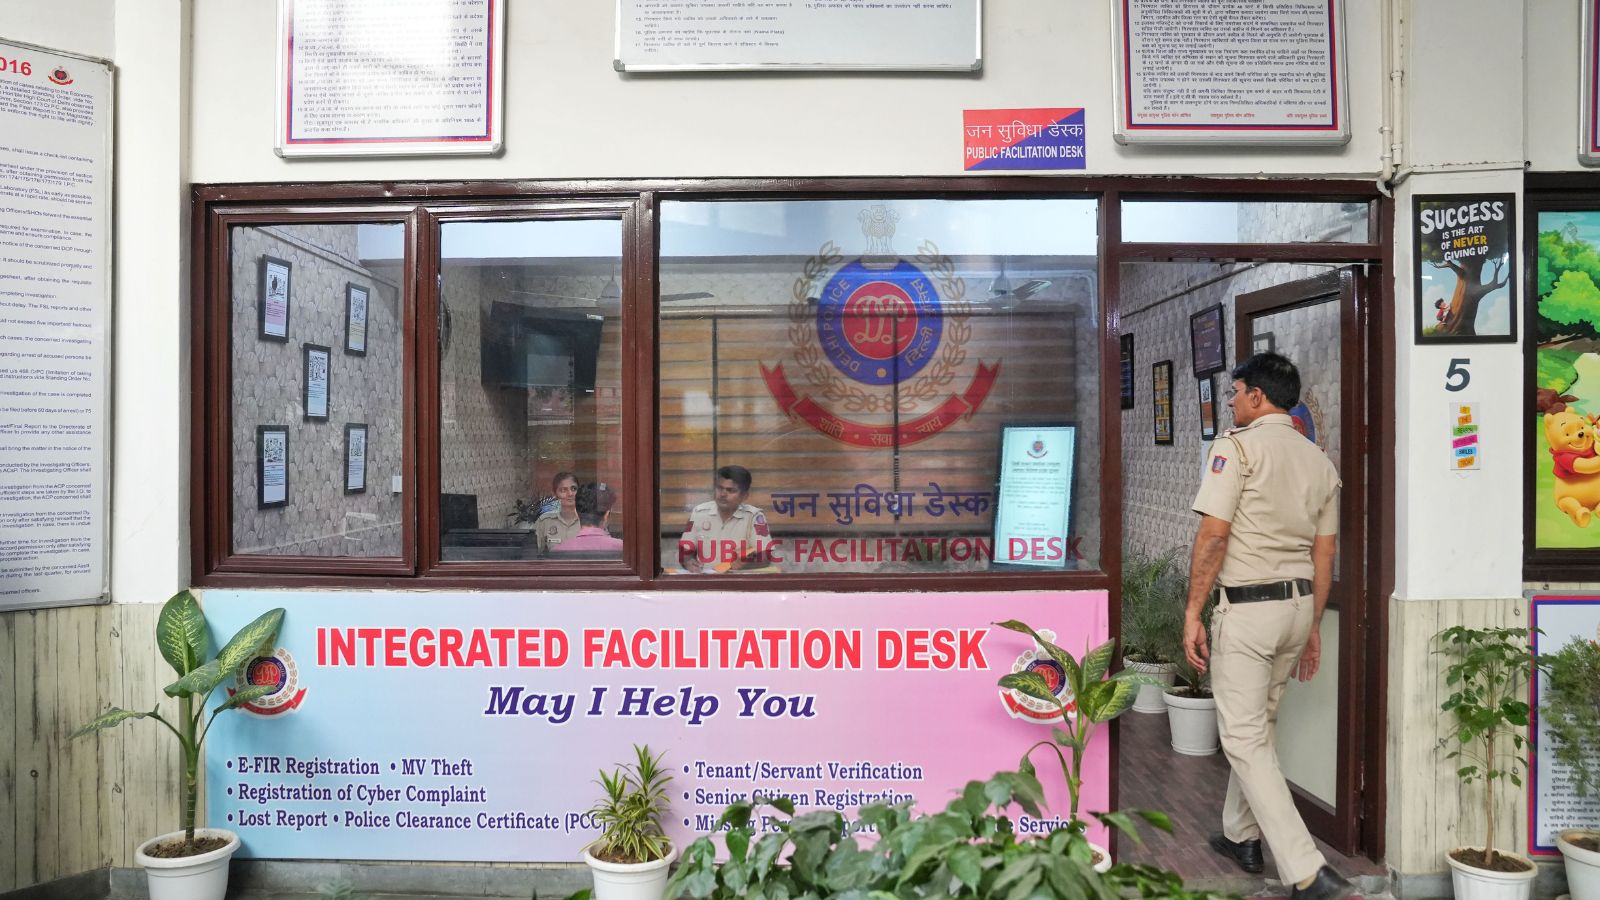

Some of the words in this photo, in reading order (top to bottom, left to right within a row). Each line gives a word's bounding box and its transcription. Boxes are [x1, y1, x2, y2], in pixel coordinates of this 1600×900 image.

[966, 125, 992, 138] जन
[997, 120, 1043, 143] सुविधा
[1047, 120, 1083, 137] डेस्क
[967, 147, 998, 159] PUBLIC
[1000, 146, 1057, 158] FACILITATION
[1060, 146, 1084, 158] DESK
[1421, 201, 1504, 234] SUCCESS
[1441, 241, 1451, 250] OF
[1453, 235, 1488, 248] NEVER
[1451, 228, 1465, 237] THE
[1468, 226, 1484, 234] ART
[1444, 248, 1476, 261] GIVING
[1478, 246, 1488, 255] UP
[824, 278, 850, 331] POLICE
[826, 336, 860, 372] DELHI
[1445, 358, 1470, 392] 5
[821, 417, 844, 438] शांति
[870, 430, 892, 445] सेवा
[916, 416, 942, 433] न्याय
[771, 492, 819, 518] जन
[826, 483, 914, 525] सुविधा
[924, 482, 994, 518] डेस्क
[679, 540, 783, 563] PUBLIC
[795, 538, 995, 563] FACILITATION
[1008, 536, 1084, 561] DESK
[317, 628, 569, 667] INTEGRATED
[583, 629, 861, 669] FACILITATION
[877, 630, 989, 670] DESK
[484, 686, 575, 724] May
[587, 687, 607, 716] I
[618, 687, 719, 725] Help
[736, 687, 816, 718] You
[238, 757, 281, 773] E-FIR
[286, 757, 380, 778] Registration
[402, 759, 426, 775] MV
[431, 759, 473, 776] Theft
[695, 761, 822, 782] Tenant/Servant
[828, 762, 923, 780] Verification
[238, 783, 332, 804] Registration
[337, 784, 353, 800] of
[356, 784, 400, 805] Cyber
[406, 786, 486, 806] Complaint
[696, 788, 747, 804] Senior
[238, 810, 271, 826] Lost
[276, 810, 328, 830] Report
[345, 810, 390, 827] Police
[396, 811, 472, 829] Clearance
[477, 812, 560, 829] Certificate
[1020, 816, 1085, 832] Servic
